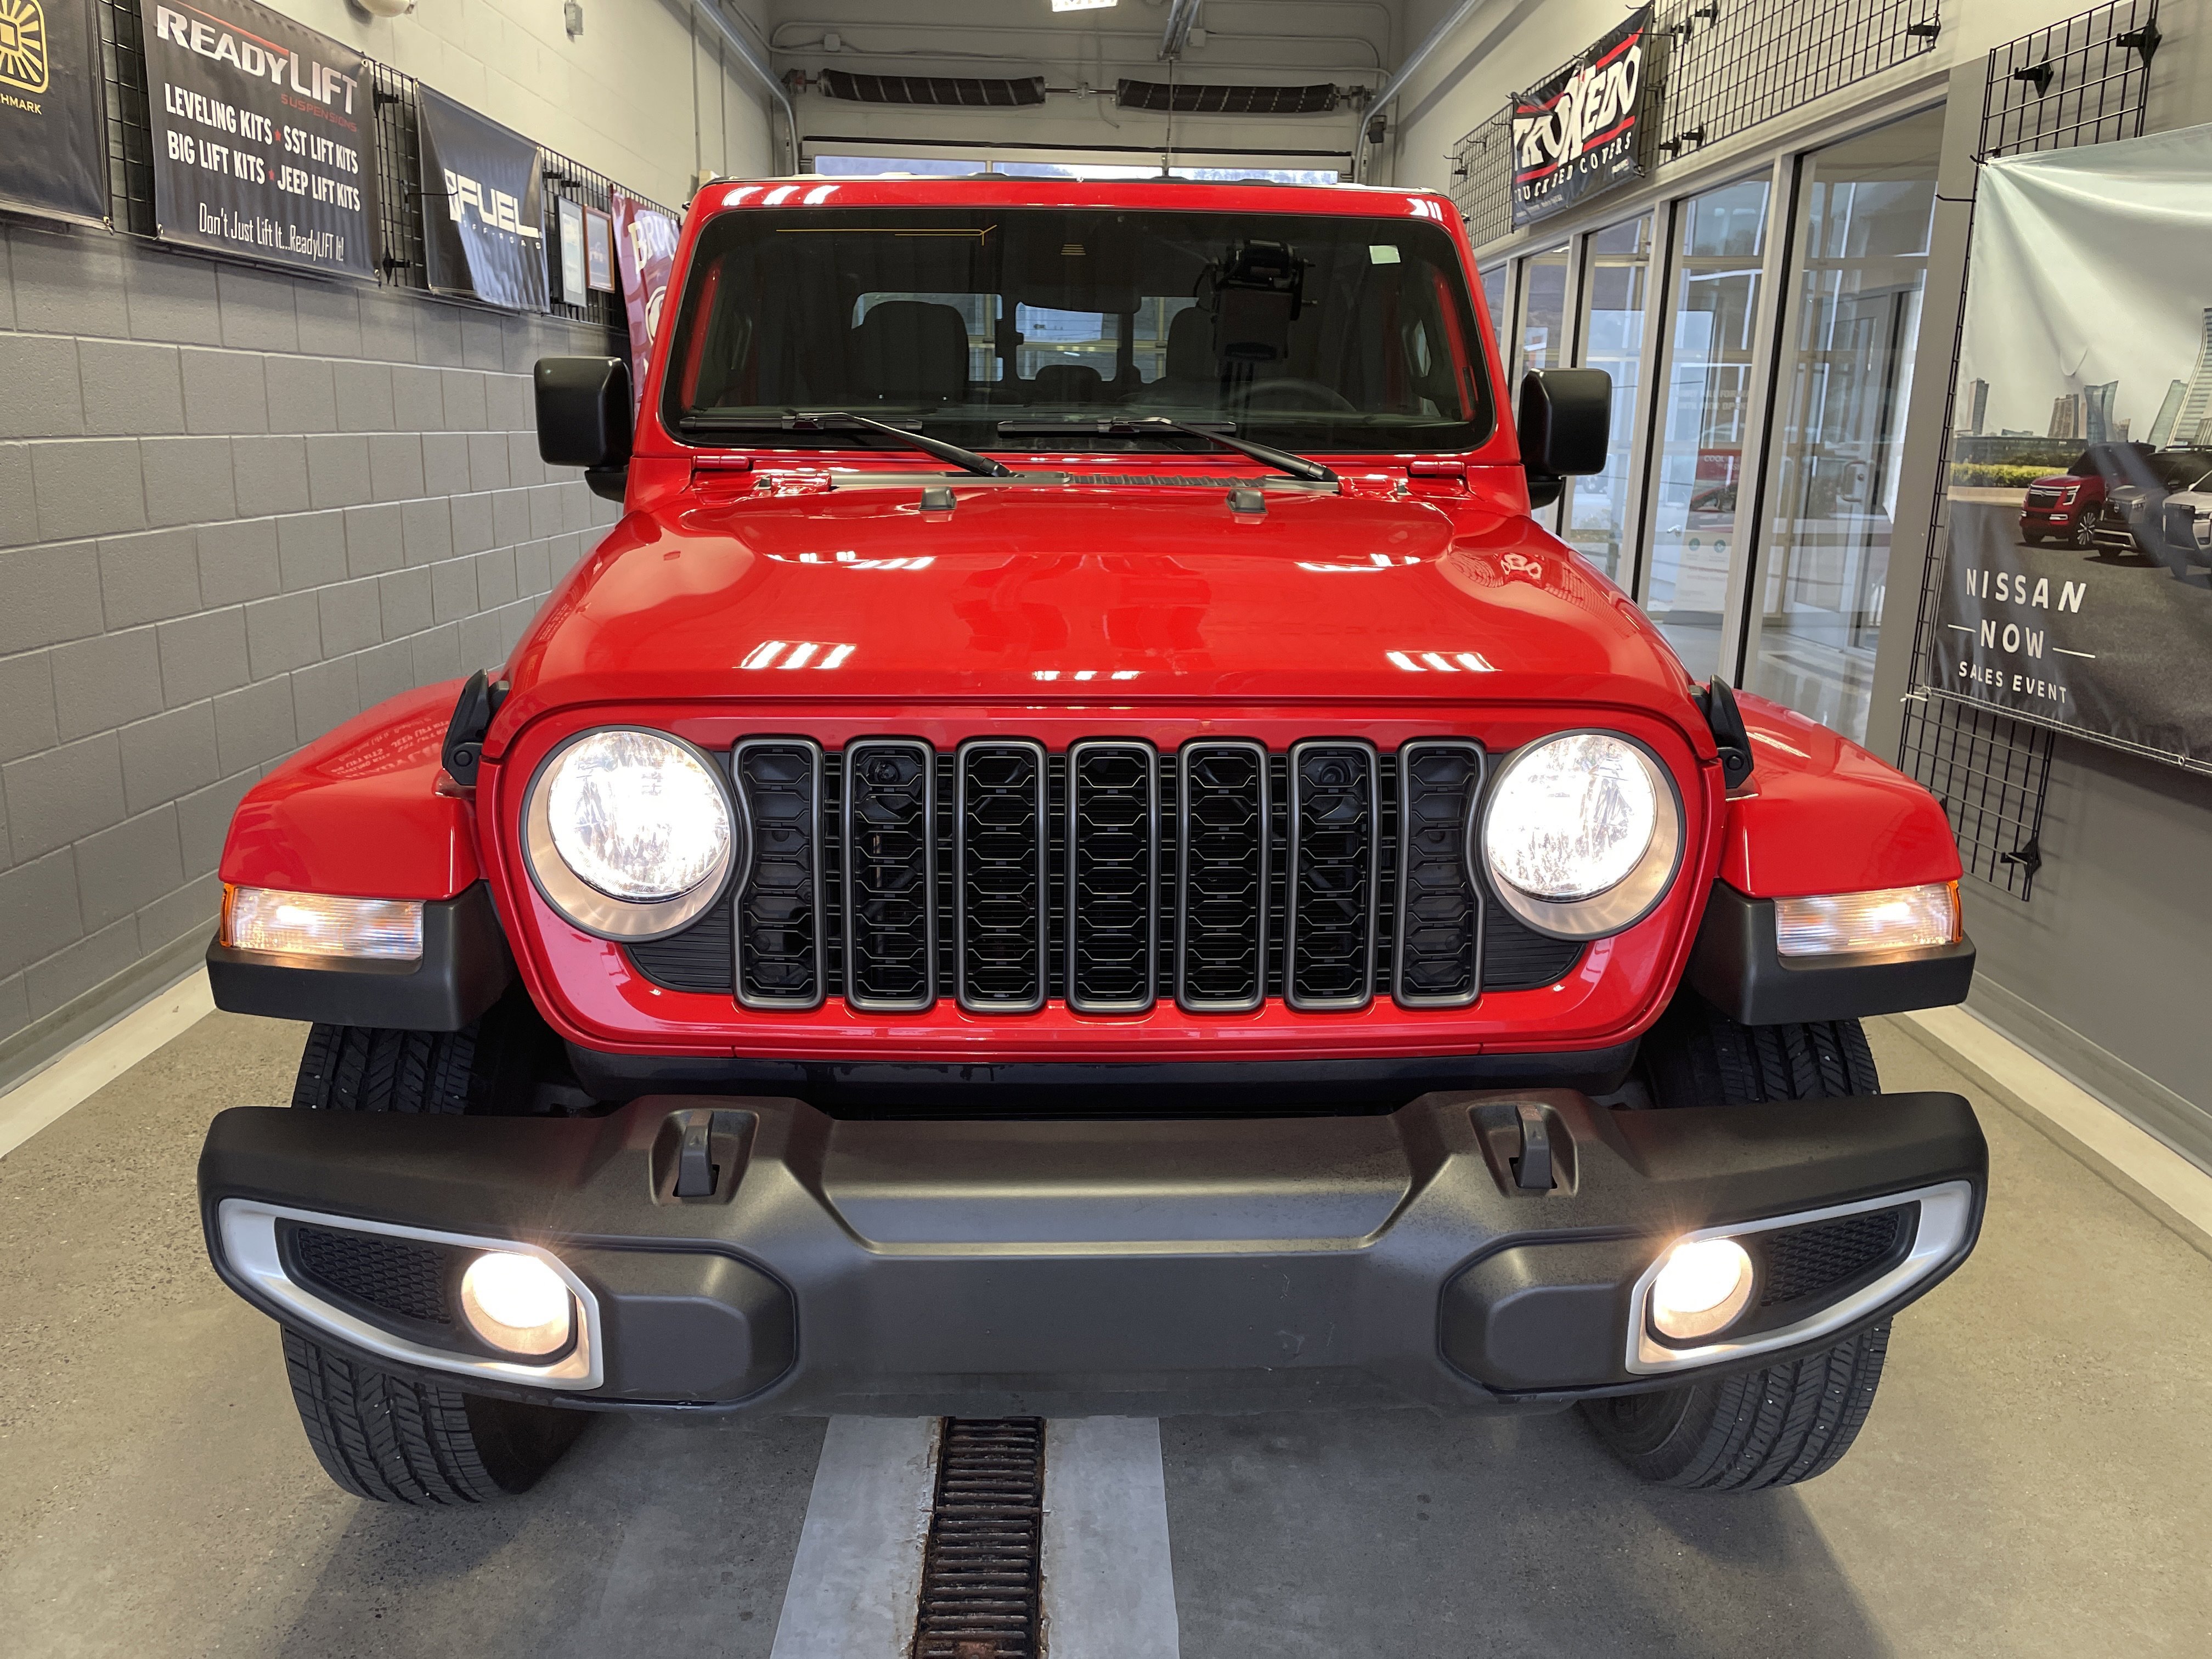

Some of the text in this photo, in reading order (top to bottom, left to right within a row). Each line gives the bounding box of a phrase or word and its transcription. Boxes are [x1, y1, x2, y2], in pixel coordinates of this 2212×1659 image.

[157, 5, 357, 115] READYLIFT
[0, 93, 42, 115] HMARK
[281, 93, 357, 132] SUSPENSIONS
[165, 82, 359, 174] LEVELING KITS SST LIFT KITS
[167, 129, 361, 212] BIG LIFT KITS JEEP LIFT KITS
[199, 202, 228, 237] Don't
[230, 211, 254, 243] Just
[257, 216, 273, 247] Lift
[457, 174, 539, 239] FUEL
[1966, 568, 2086, 613] NISSAN
[1980, 619, 2044, 659] NOW
[1959, 661, 2067, 704] SALES EVENT
